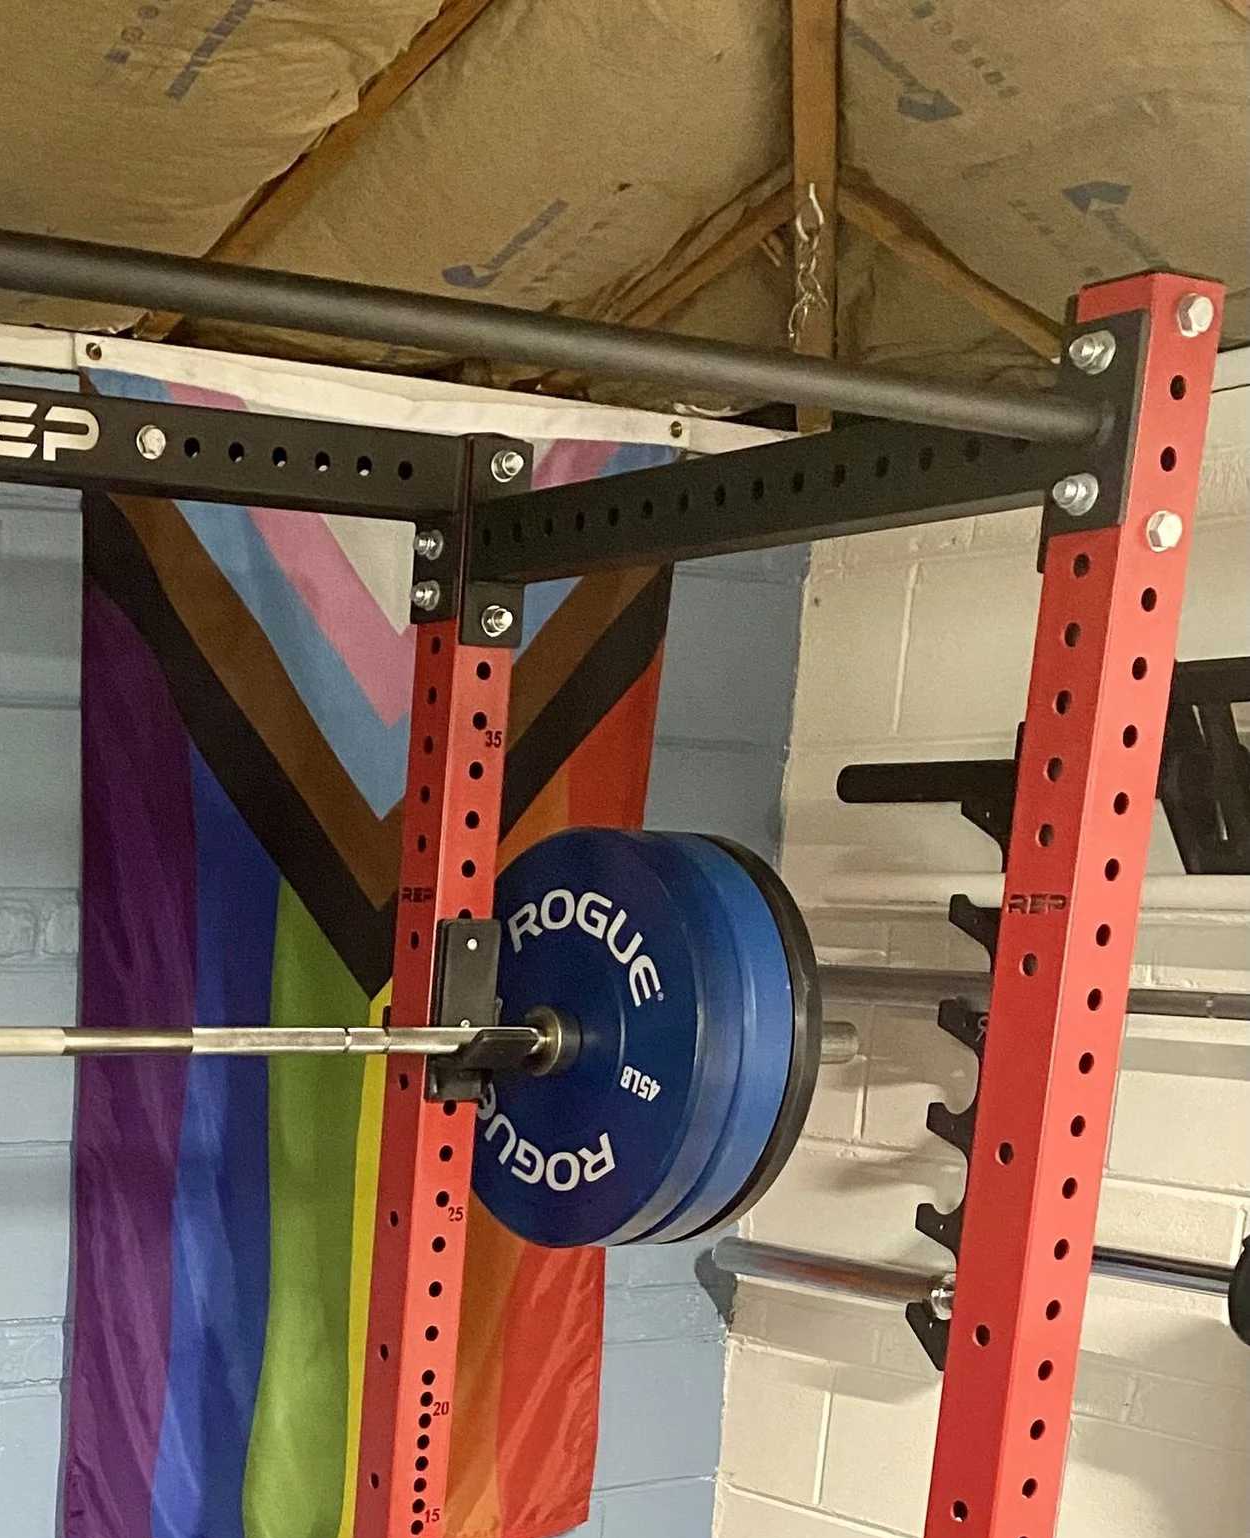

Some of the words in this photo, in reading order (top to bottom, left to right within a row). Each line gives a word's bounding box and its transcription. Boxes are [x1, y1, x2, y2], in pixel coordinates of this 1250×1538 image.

[485, 730, 502, 748] 35
[402, 886, 434, 903] REP
[1008, 893, 1066, 914] REP
[507, 888, 664, 1007] ROGUE
[620, 1065, 661, 1102] 45LB
[448, 1206, 464, 1221] 25
[433, 1401, 450, 1417] 20
[424, 1508, 441, 1523] 15
